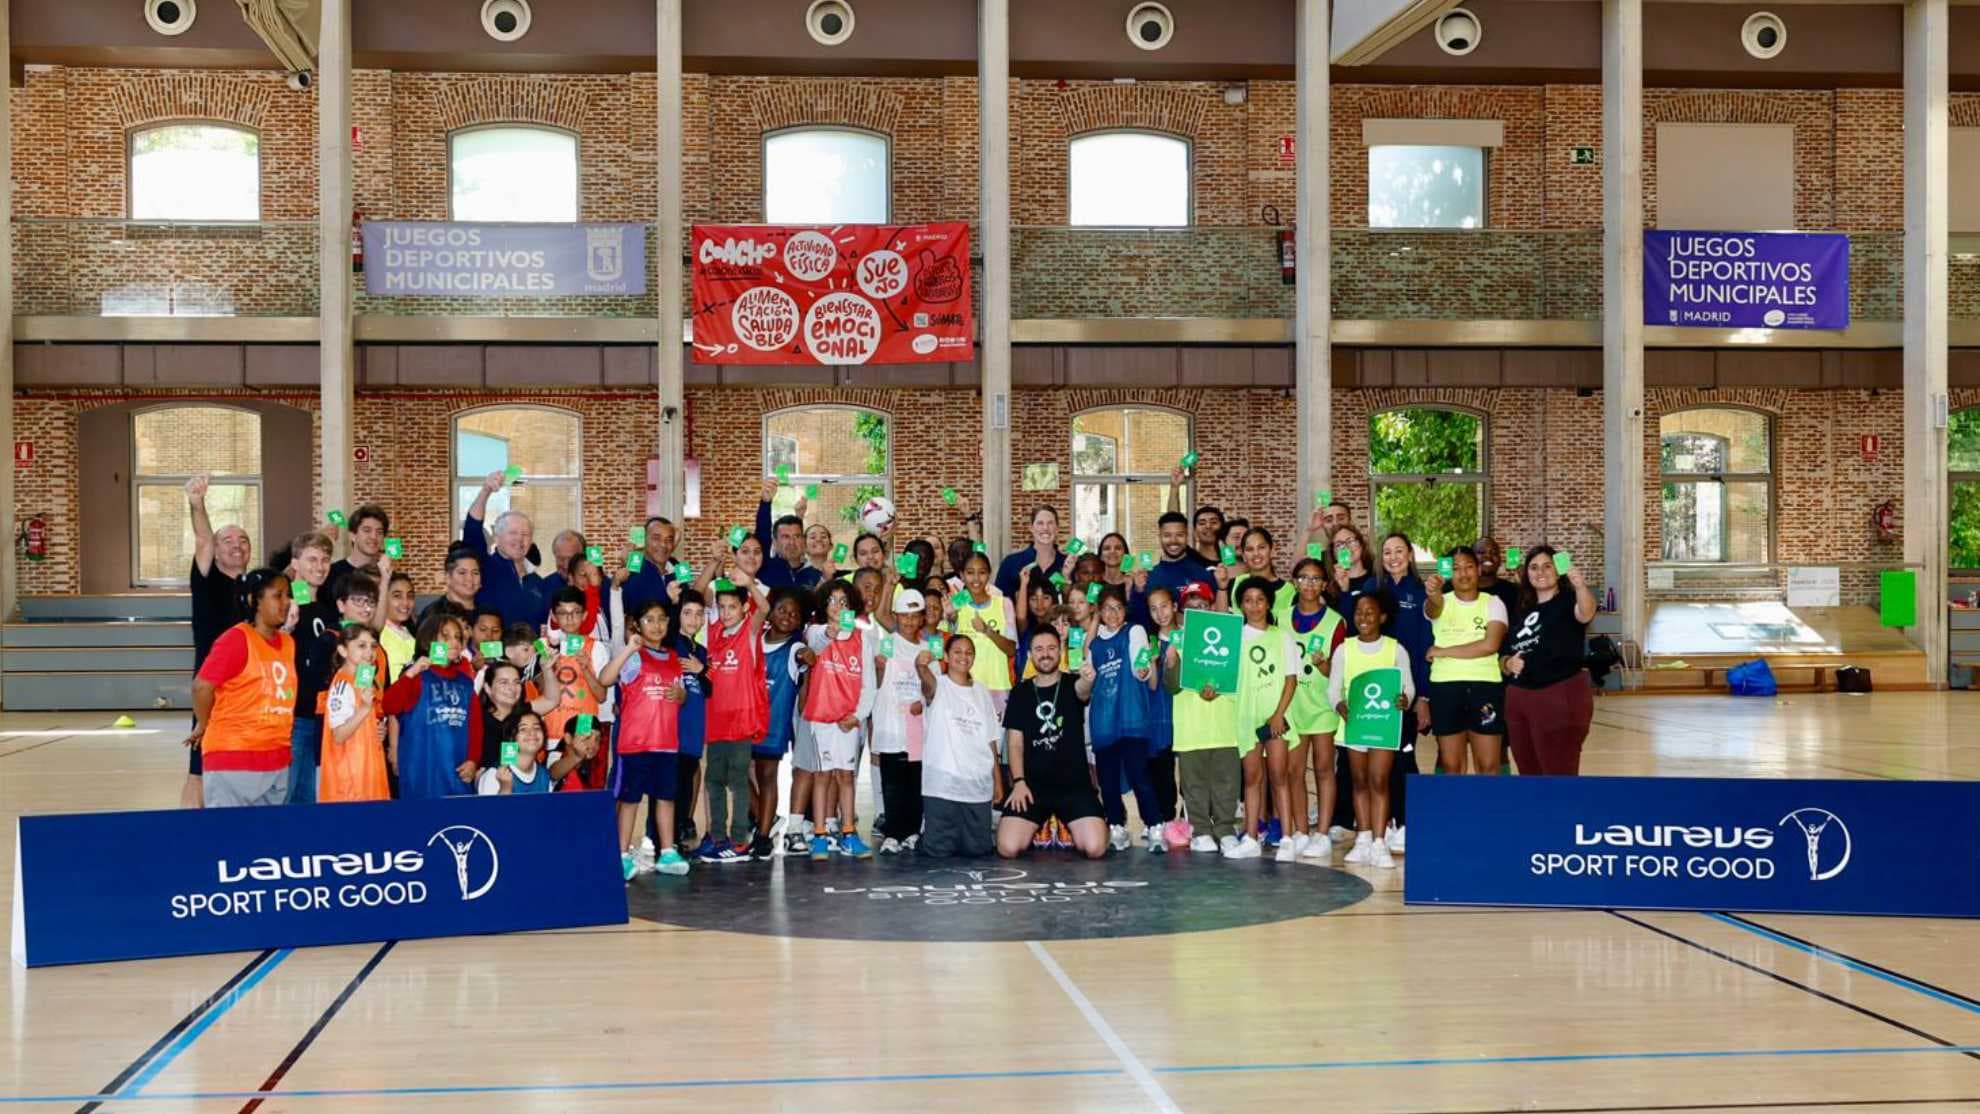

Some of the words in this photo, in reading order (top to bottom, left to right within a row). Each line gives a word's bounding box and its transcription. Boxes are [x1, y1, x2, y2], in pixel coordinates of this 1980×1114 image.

[383, 228, 481, 249] JUEGOS
[786, 240, 834, 256] ACTIVIDAD
[1667, 236, 1756, 261] JUEGOS
[385, 250, 546, 268] DEPORTIVOS
[385, 271, 556, 290] MUNICIPALES
[1670, 260, 1812, 282] DEPORTIVOS
[1669, 283, 1817, 306] MUNICIPALES
[1684, 310, 1731, 322] MADRID
[1531, 853, 1618, 877] SPORT
[1625, 855, 1679, 878] FOR
[1686, 856, 1775, 880] GOOD
[171, 890, 267, 919] SPORT
[274, 886, 331, 912] FOR
[338, 880, 427, 909] GOOD
